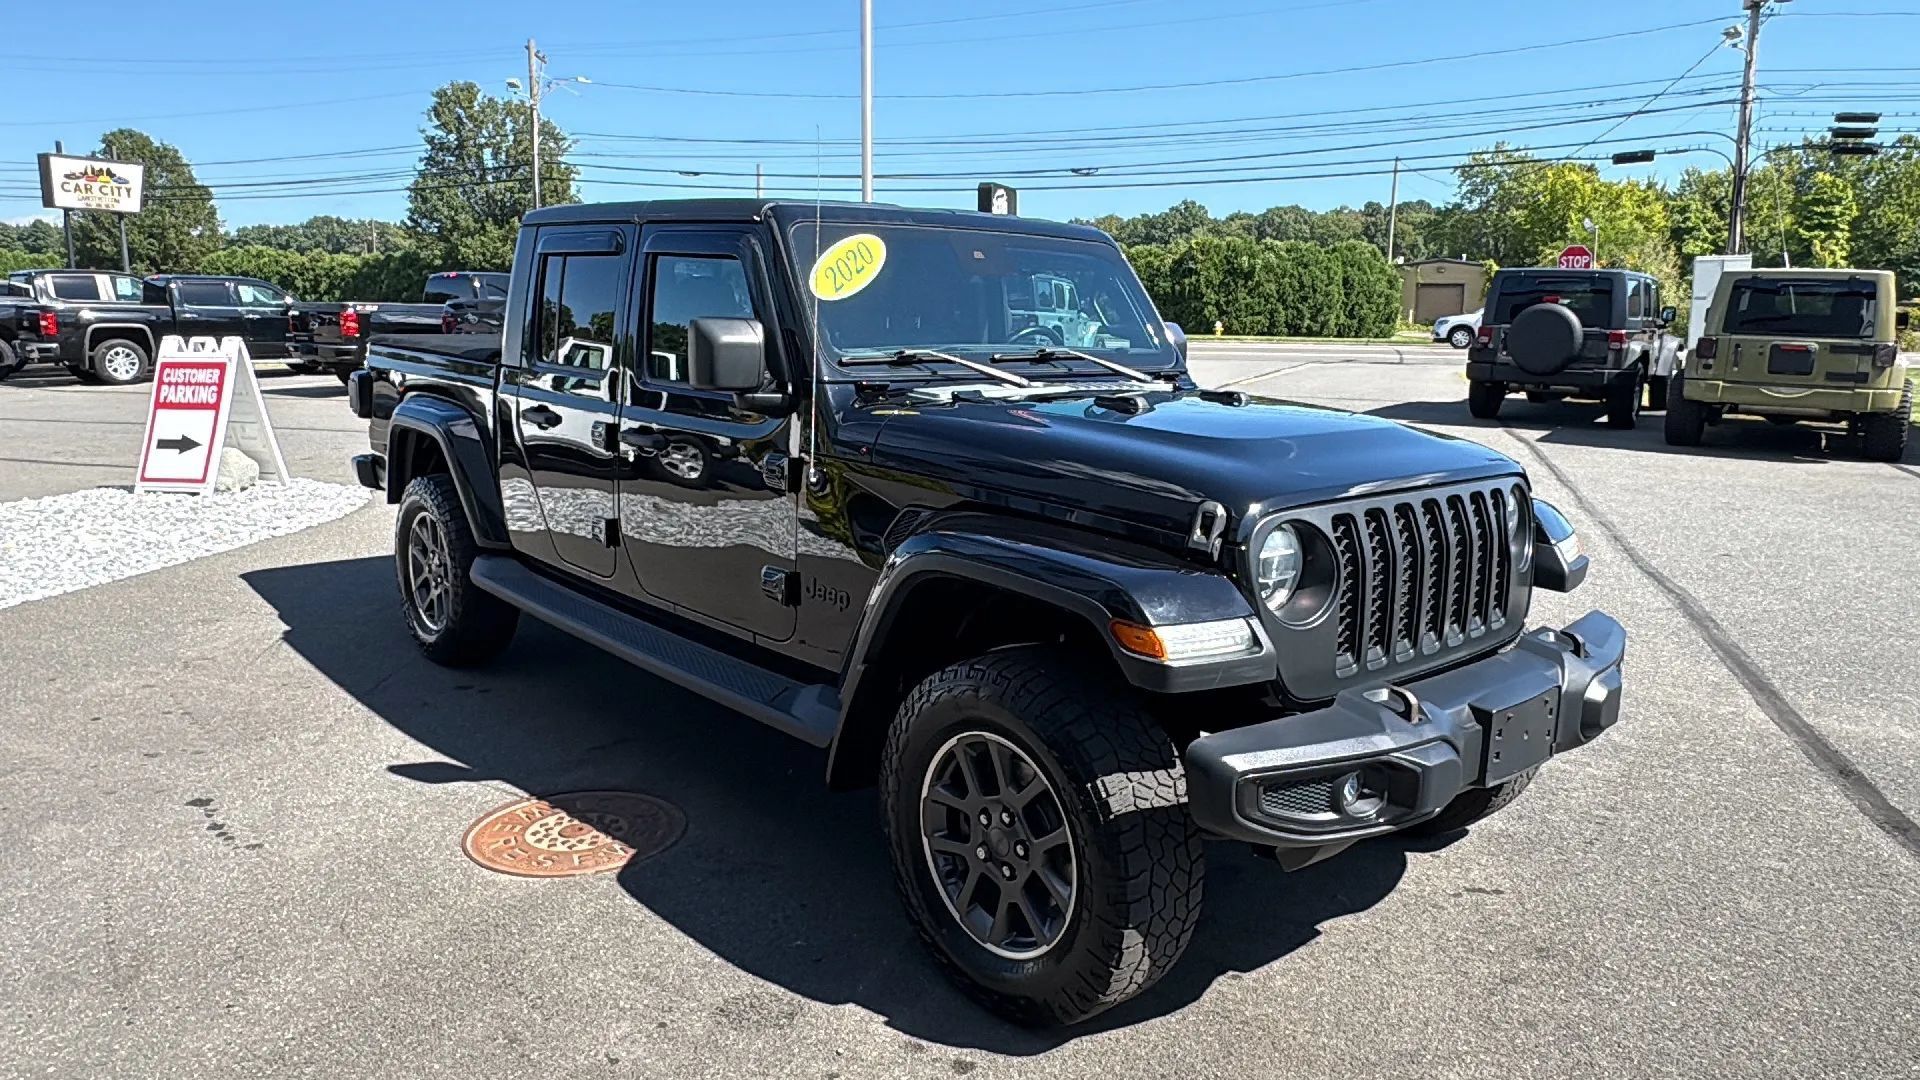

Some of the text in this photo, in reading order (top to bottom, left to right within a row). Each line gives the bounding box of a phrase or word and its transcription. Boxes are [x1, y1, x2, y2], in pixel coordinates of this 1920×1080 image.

[61, 182, 132, 199] CAR CITY
[825, 241, 873, 293] 2020
[1560, 255, 1590, 268] STOP
[162, 367, 221, 384] CUSTOMER
[159, 384, 219, 404] PARKING
[806, 577, 850, 612] Jeep
